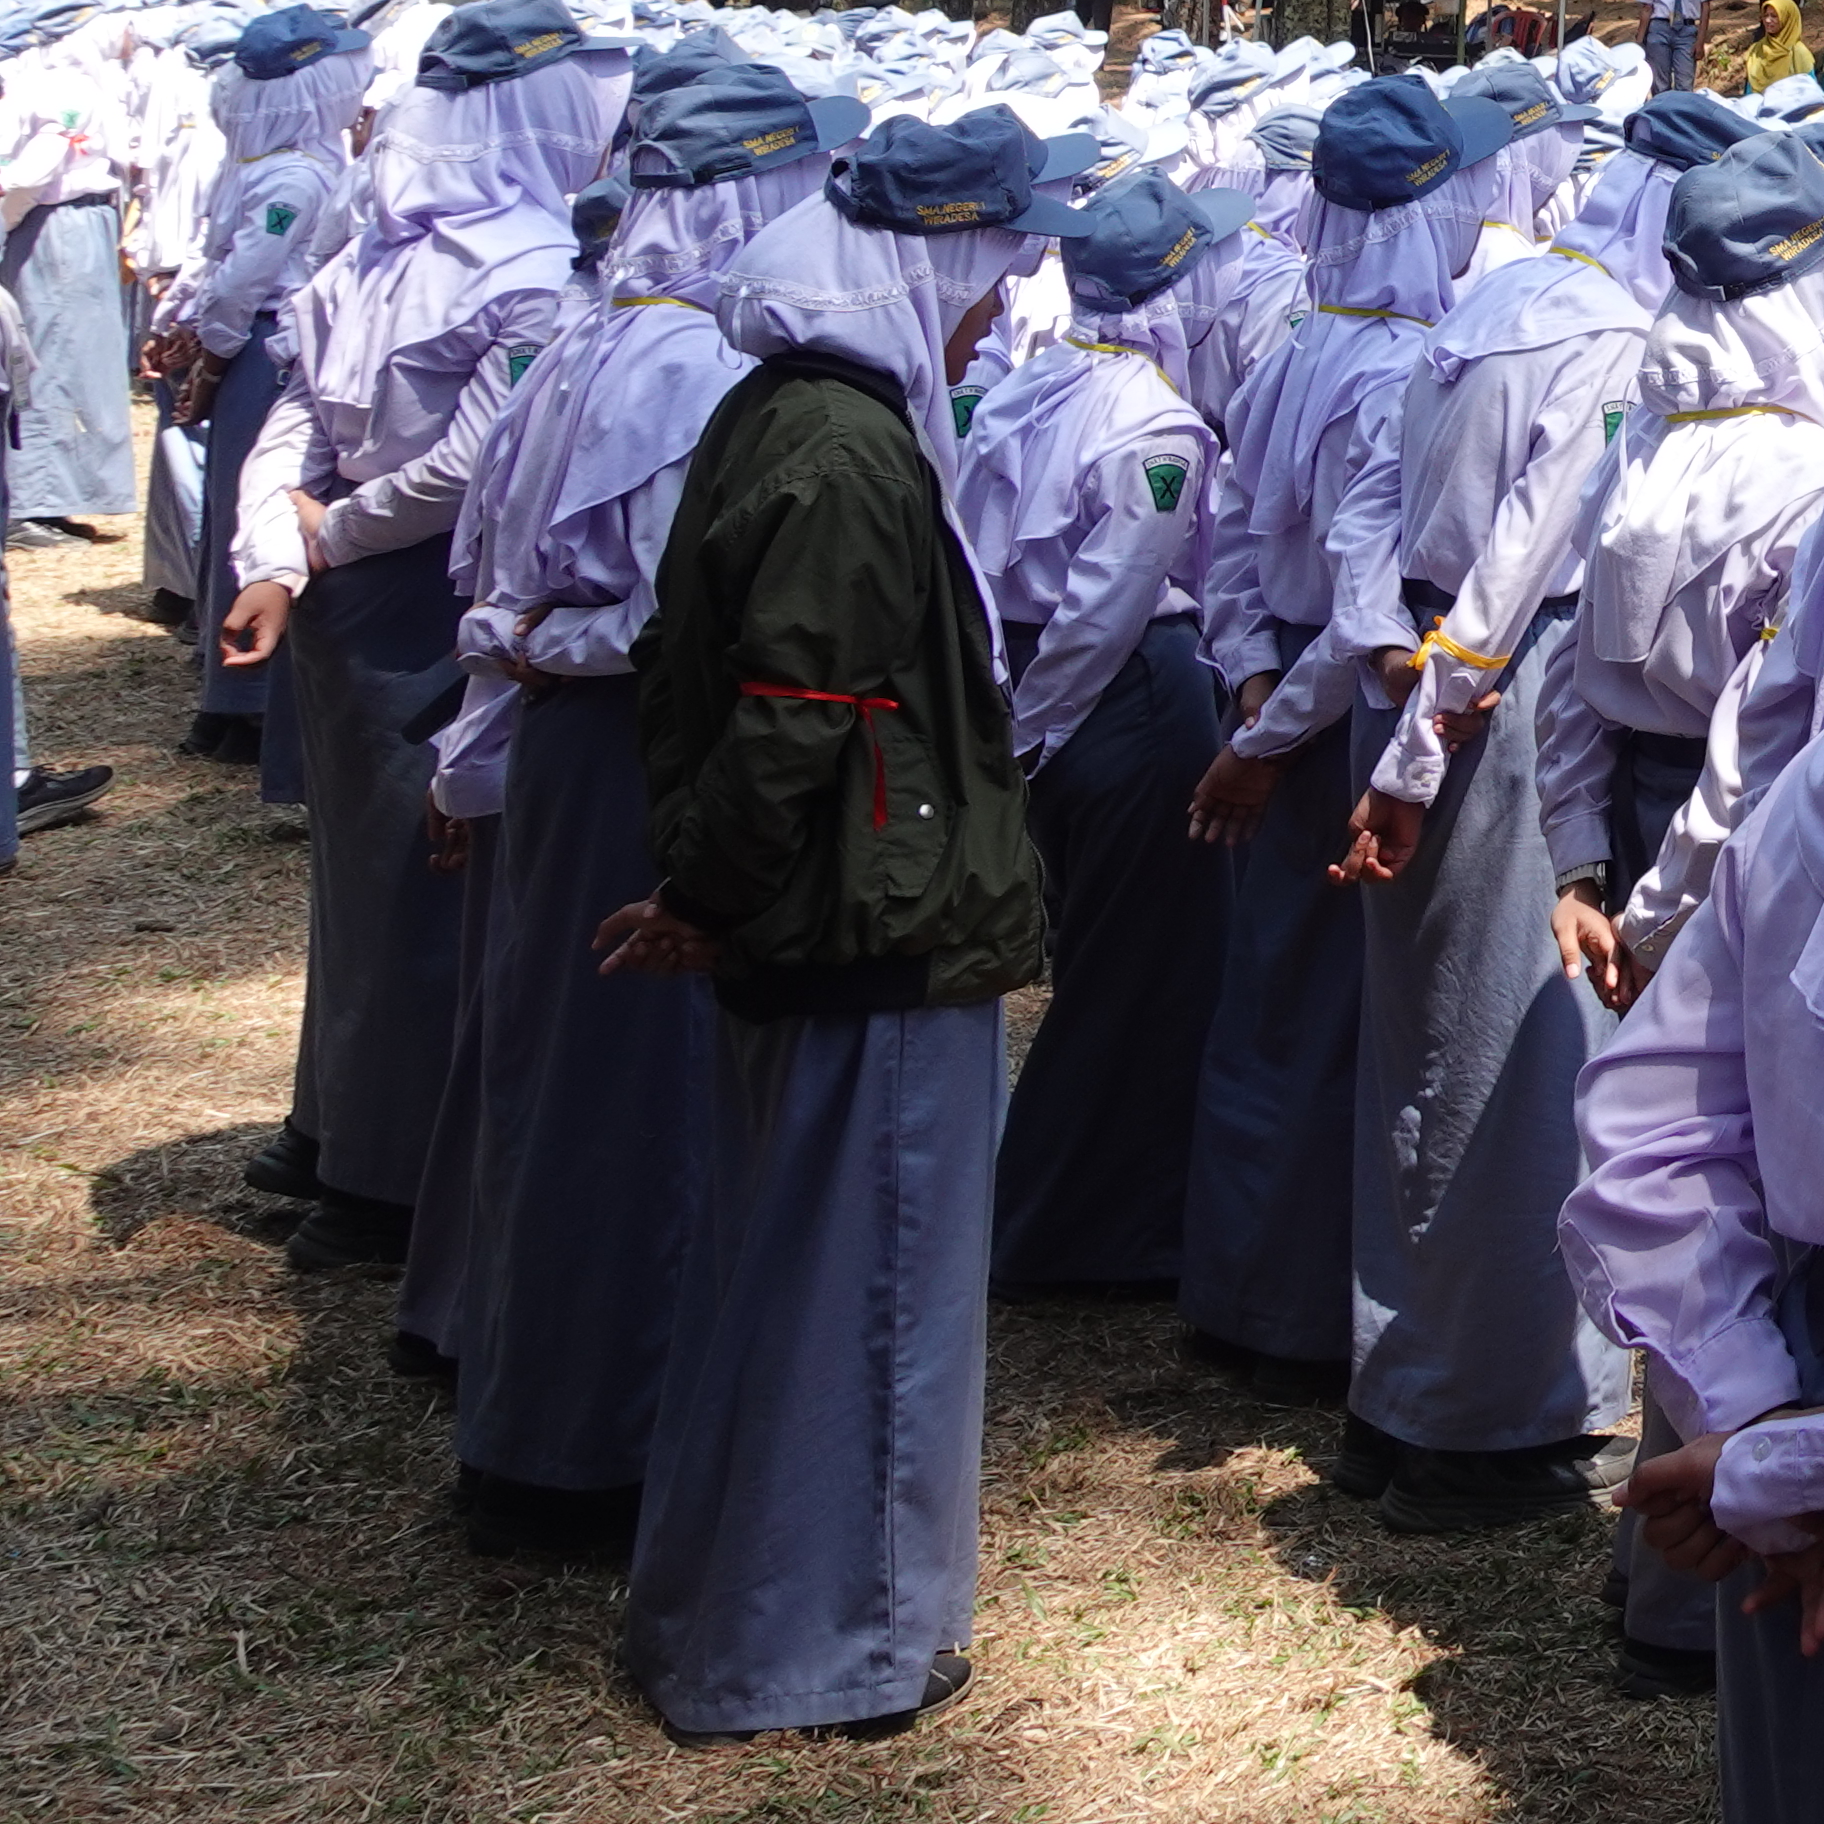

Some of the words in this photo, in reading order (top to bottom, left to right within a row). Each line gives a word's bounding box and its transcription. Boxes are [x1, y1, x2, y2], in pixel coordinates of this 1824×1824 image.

[917, 203, 939, 216] SMA
[942, 201, 979, 213] NEGERI
[923, 211, 980, 226] WIRADESA
[1769, 235, 1792, 257] SMA
[1790, 219, 1824, 241] NEGERI
[1160, 476, 1177, 500] X
